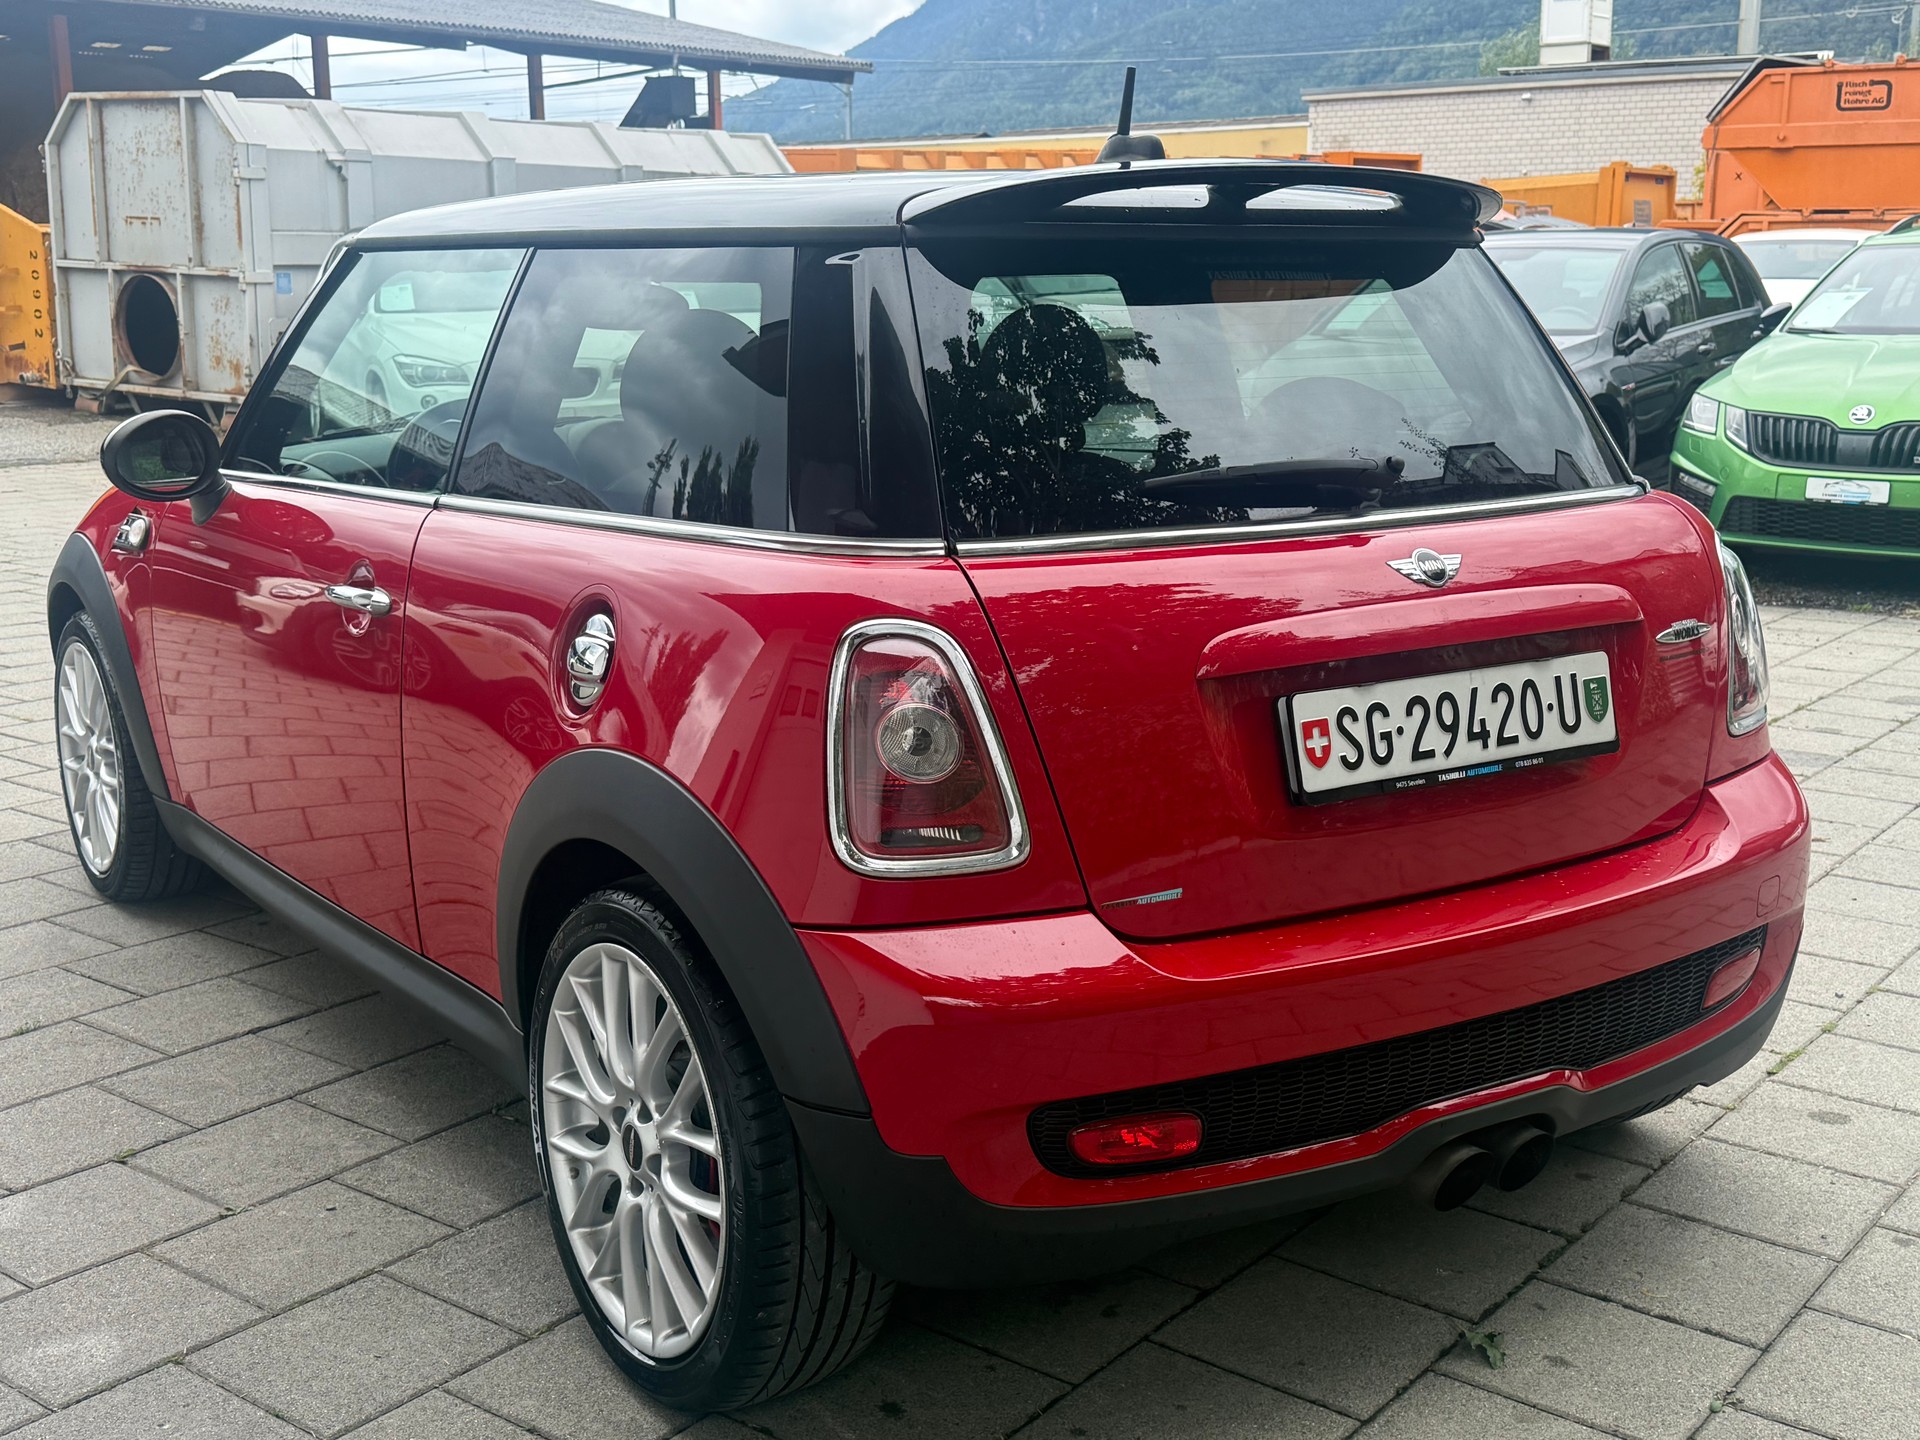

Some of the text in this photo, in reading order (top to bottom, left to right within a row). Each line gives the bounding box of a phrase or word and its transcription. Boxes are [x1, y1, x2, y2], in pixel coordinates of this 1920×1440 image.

[1418, 559, 1446, 571] MINI
[1673, 625, 1700, 641] WORKS
[1466, 764, 1504, 777] AUTOMOBILE
